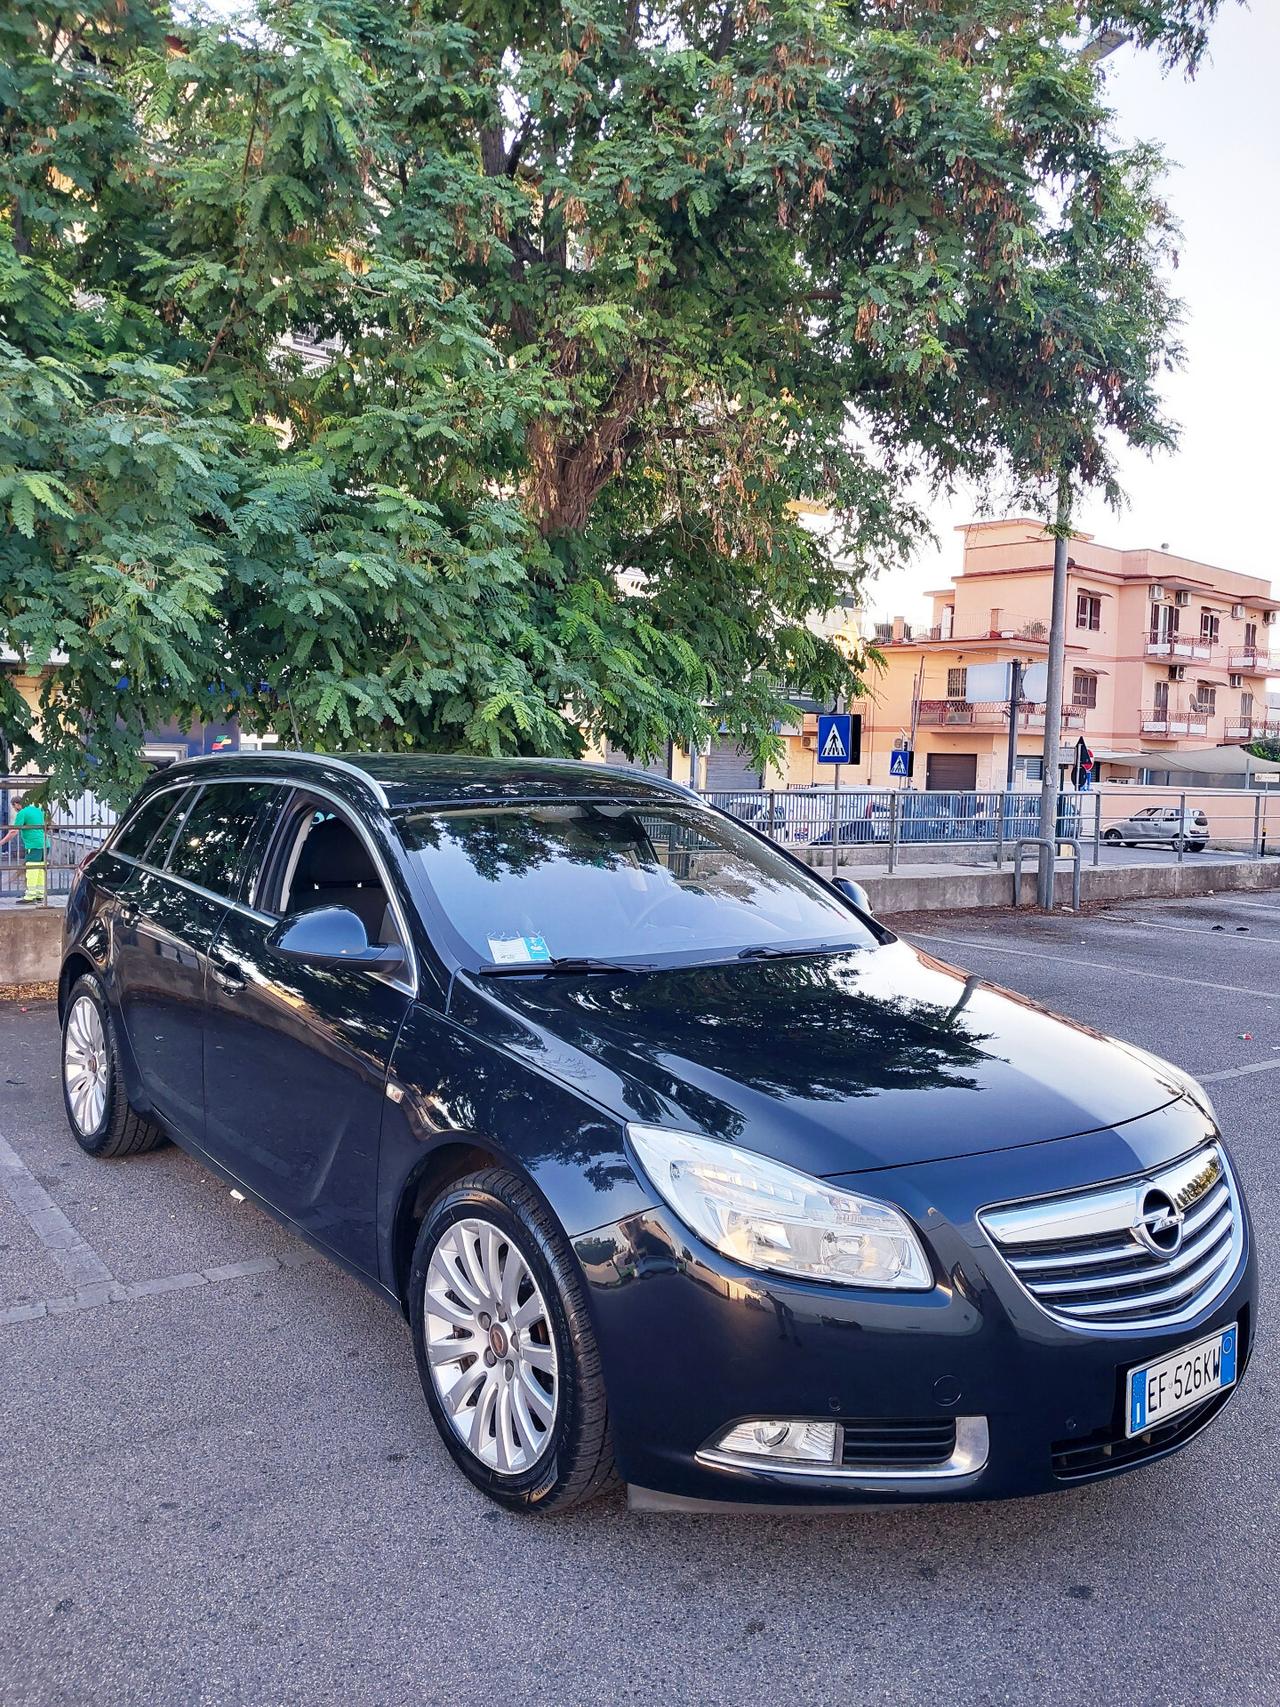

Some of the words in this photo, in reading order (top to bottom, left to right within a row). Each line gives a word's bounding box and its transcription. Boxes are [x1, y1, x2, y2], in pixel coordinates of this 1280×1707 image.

[1148, 1371, 1168, 1413] EF
[1173, 1346, 1221, 1400] 526KW
[1136, 1402, 1141, 1424] I
